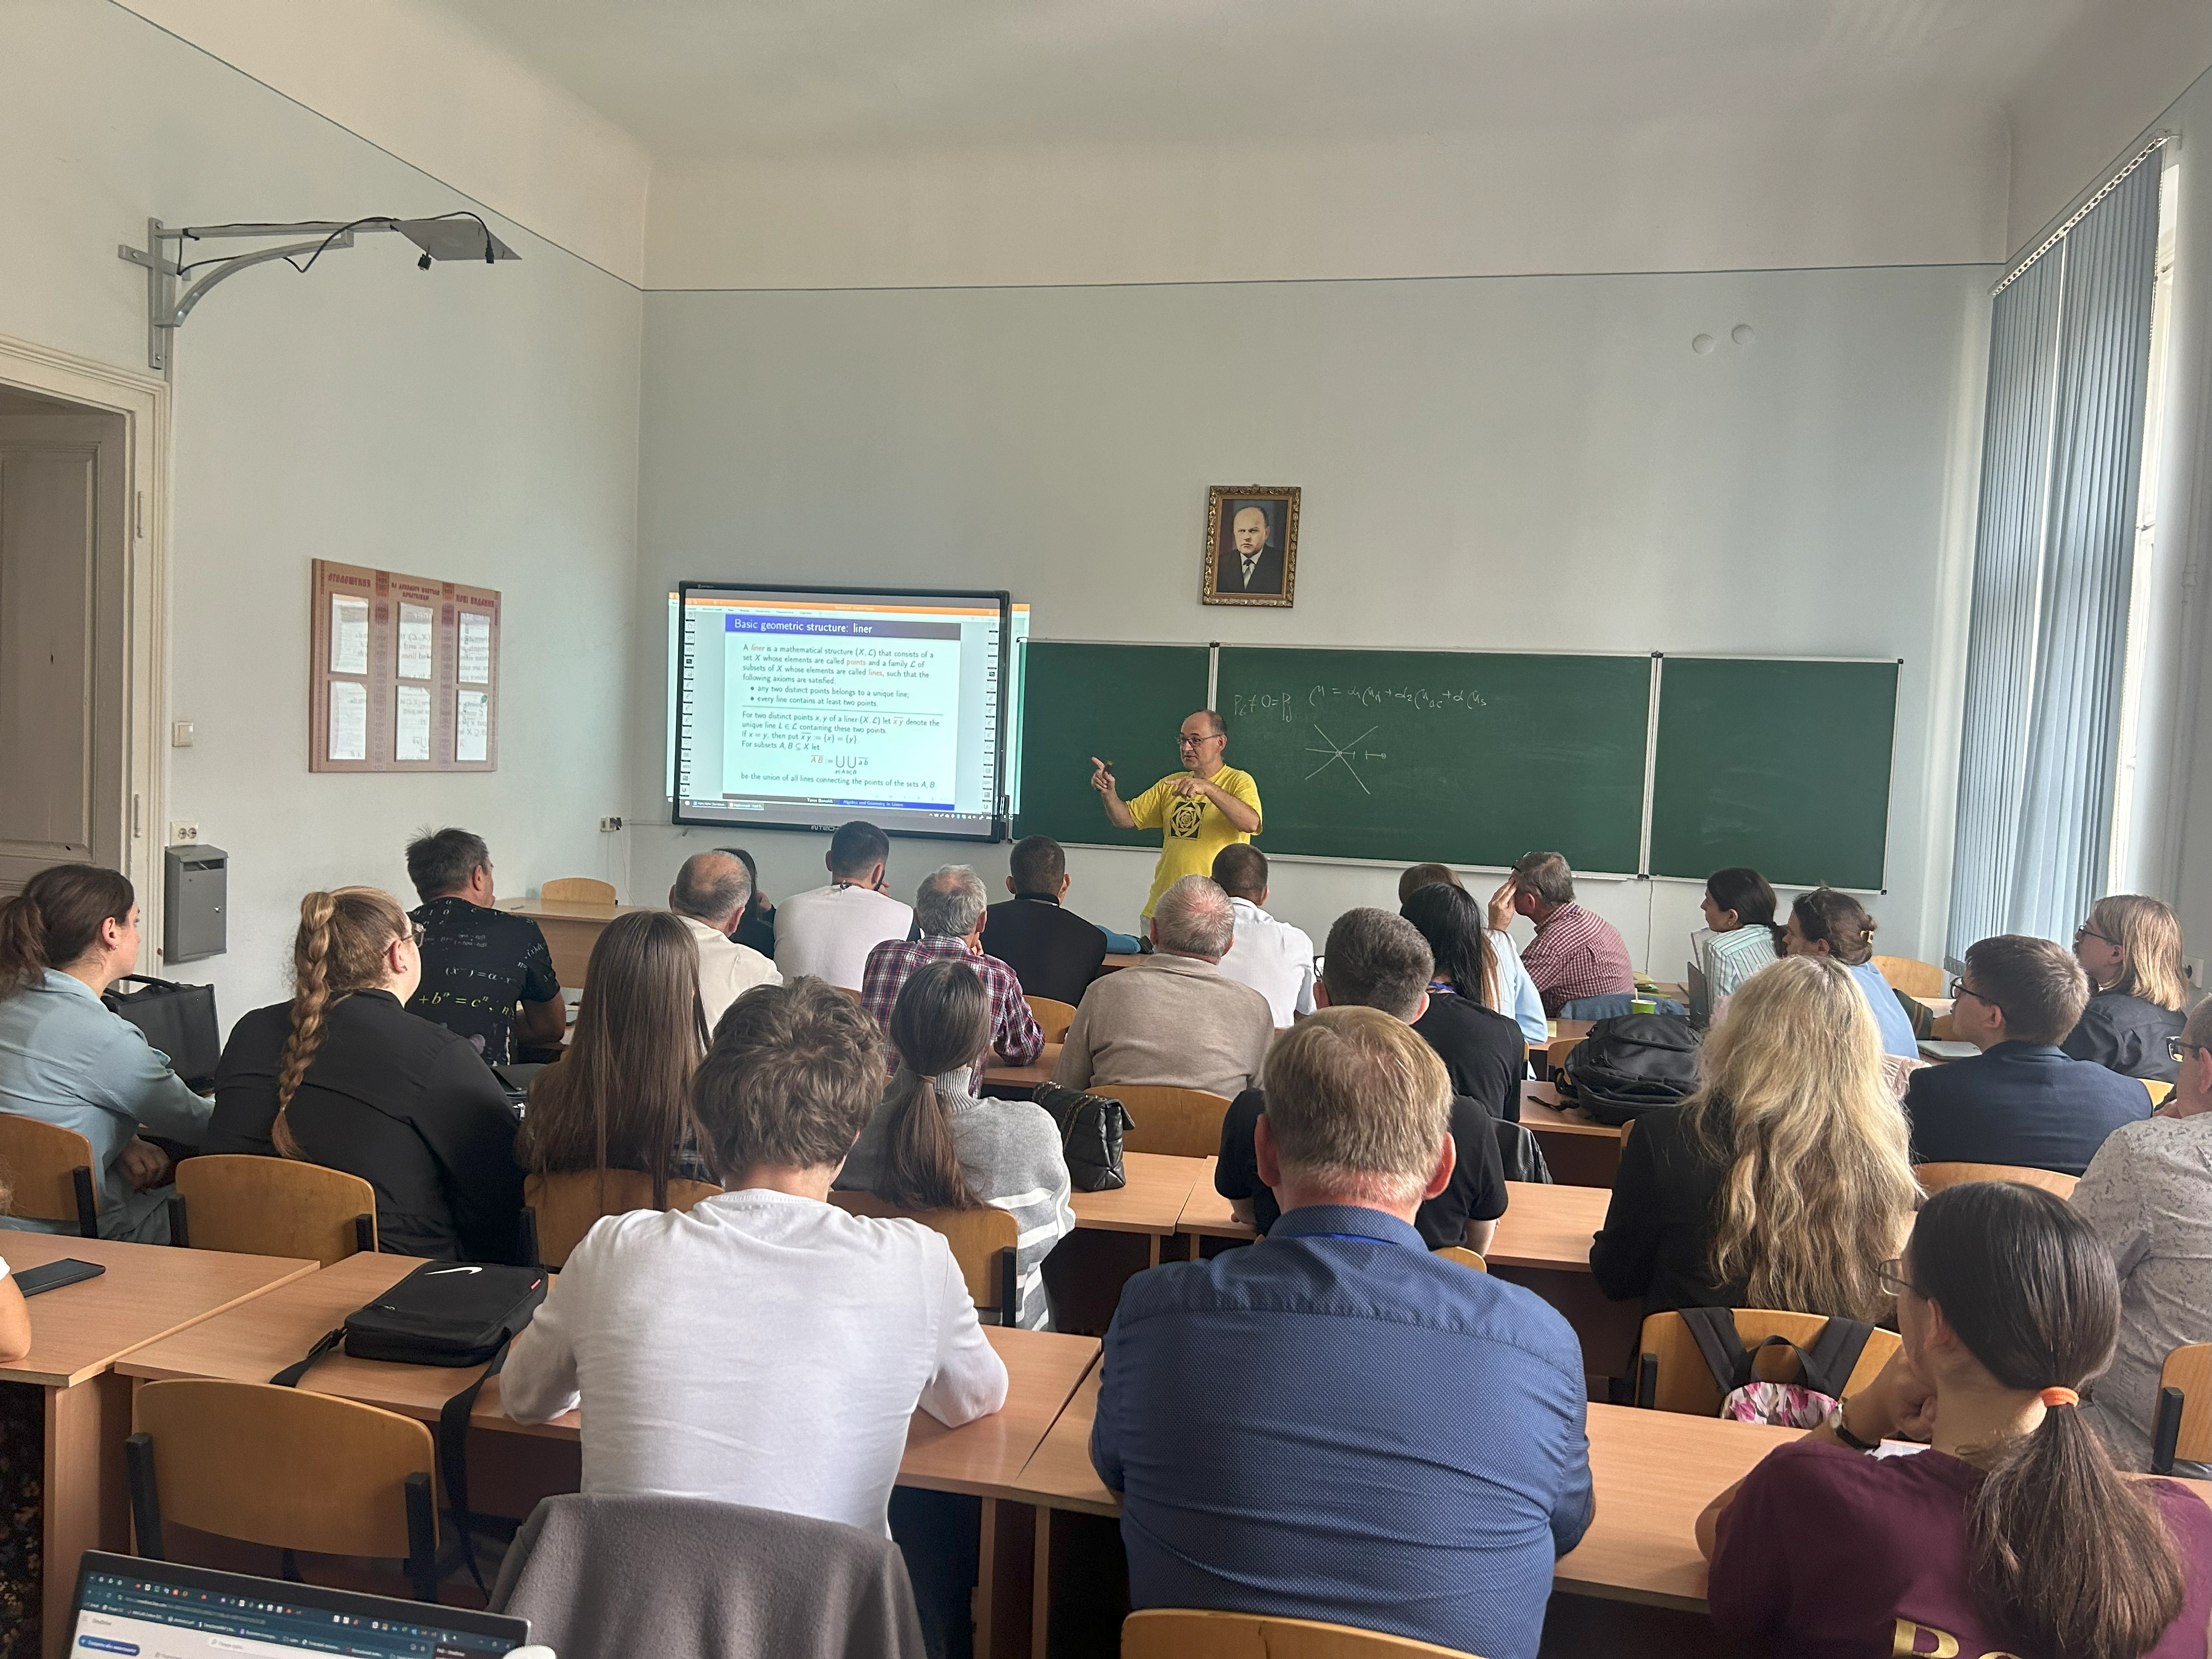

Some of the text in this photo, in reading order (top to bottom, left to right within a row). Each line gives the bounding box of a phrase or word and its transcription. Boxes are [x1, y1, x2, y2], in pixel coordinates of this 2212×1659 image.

[735, 619, 873, 634] Basic geometric structure: liner
[780, 645, 822, 653] mathematical
[825, 647, 853, 655] structure
[826, 657, 844, 665] called
[889, 659, 907, 668] family
[806, 666, 834, 674] elements
[868, 669, 884, 677] lines,
[743, 674, 770, 683] following
[785, 685, 808, 693] distinct
[832, 687, 855, 697] belongs
[896, 690, 909, 698] line;
[769, 712, 792, 720] distinct
[794, 713, 813, 721] points
[883, 716, 891, 724] let
[906, 718, 927, 726] denote
[816, 776, 850, 786] connecting
